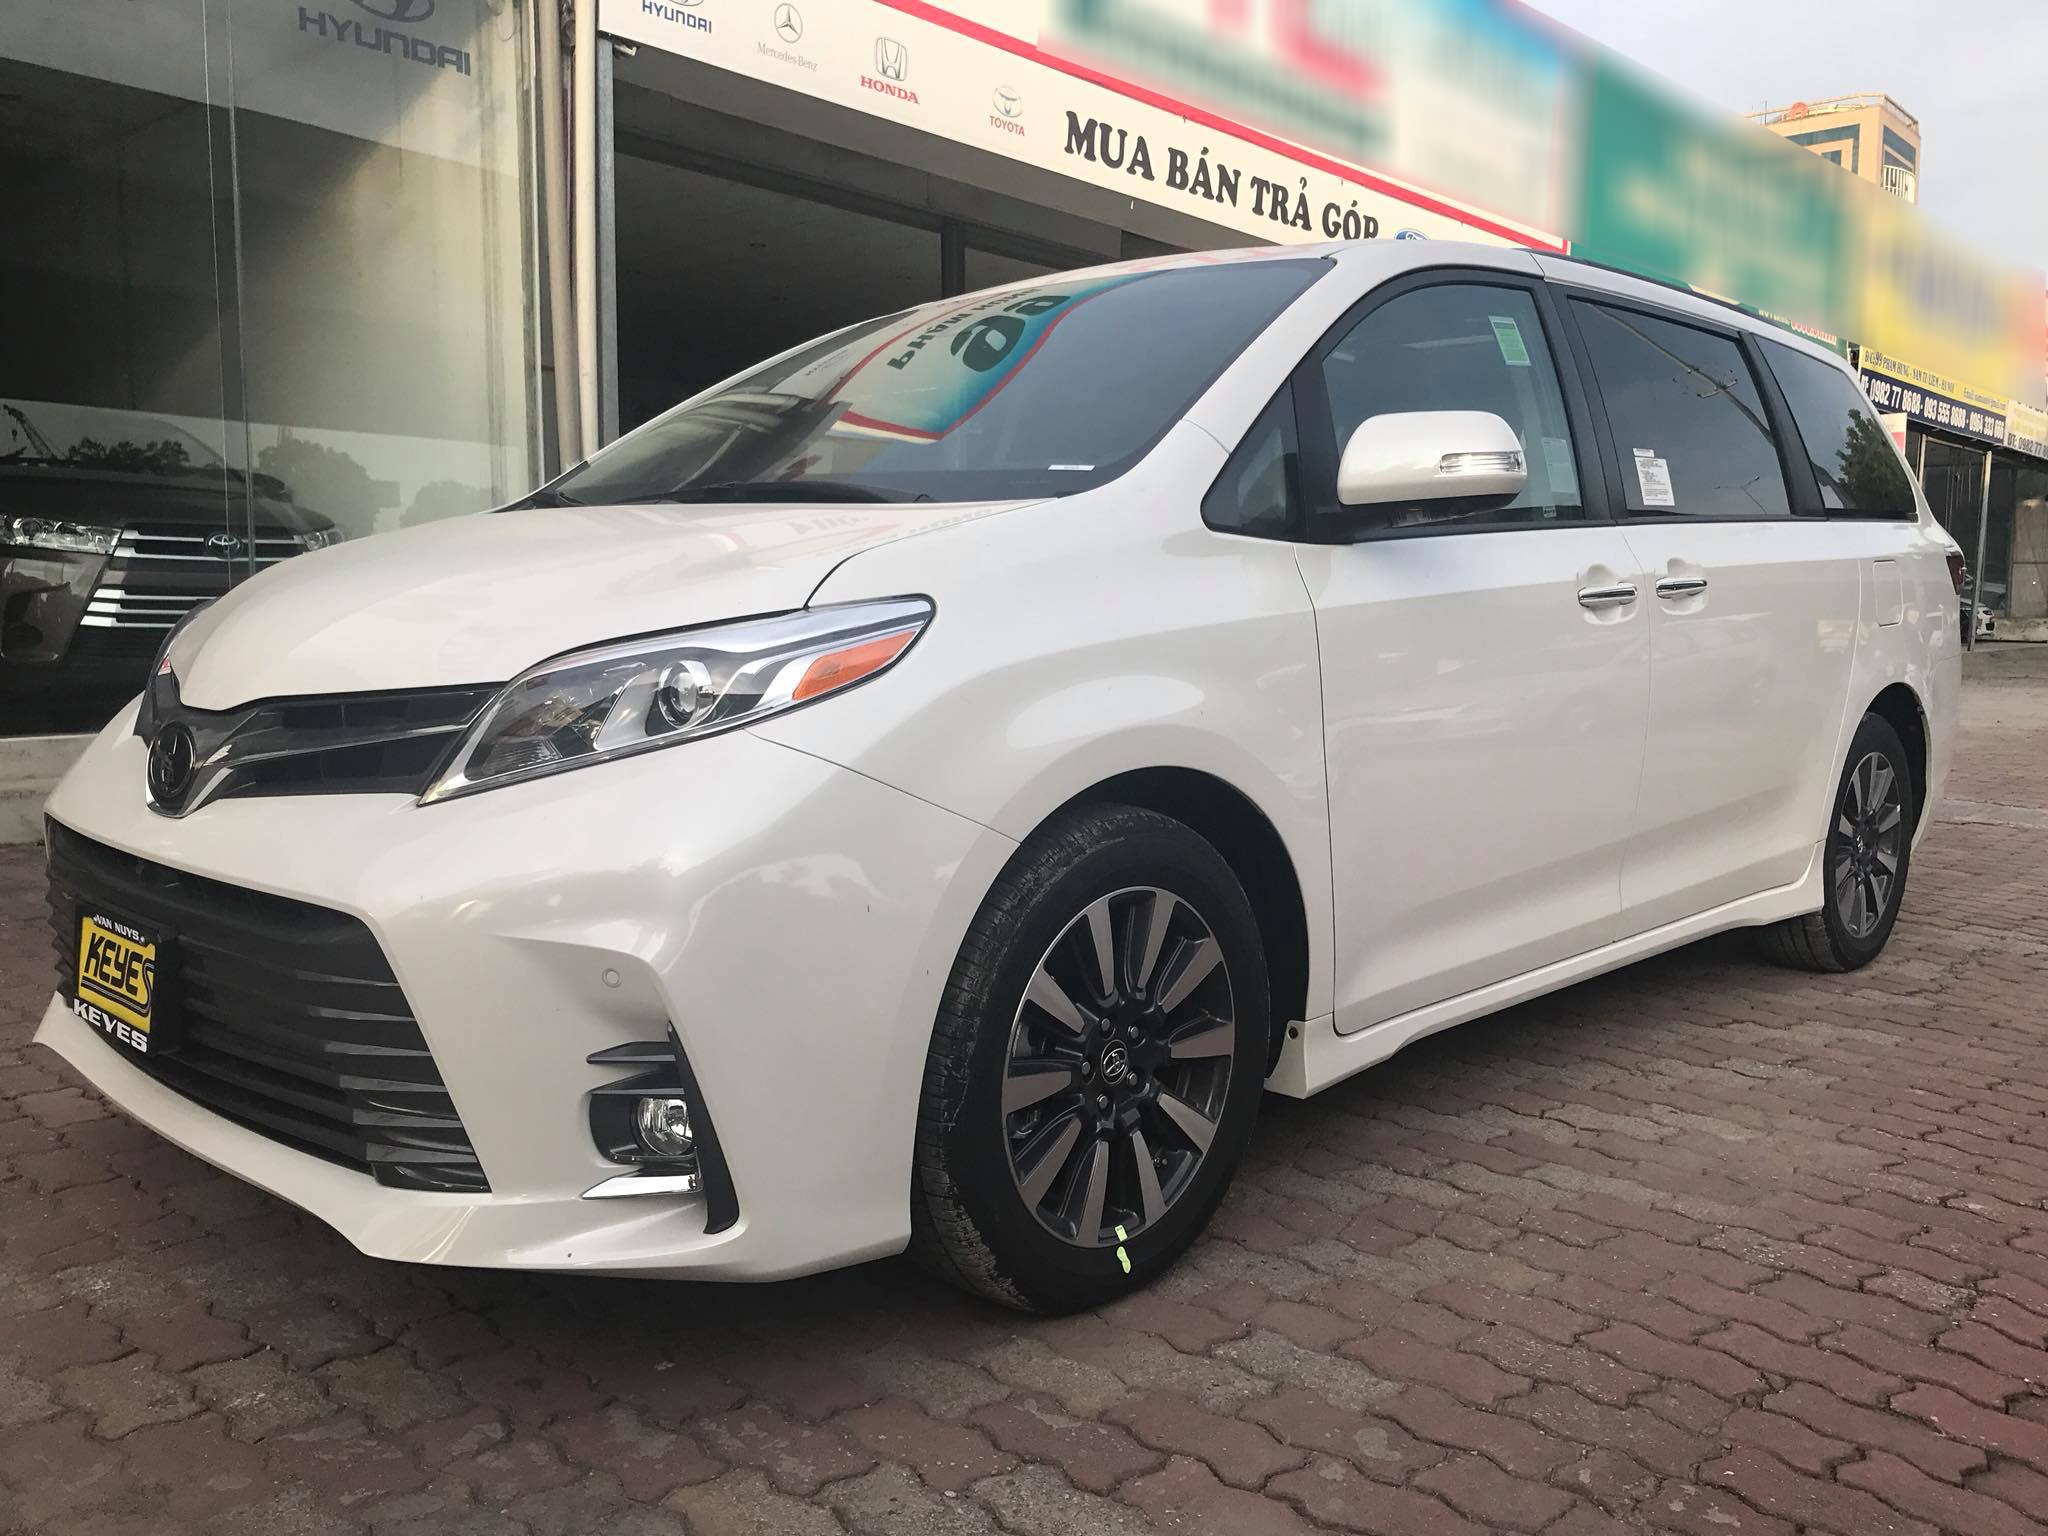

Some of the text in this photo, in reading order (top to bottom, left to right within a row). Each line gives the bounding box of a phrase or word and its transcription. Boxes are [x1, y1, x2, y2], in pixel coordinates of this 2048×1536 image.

[642, 0, 712, 34] HYUNDAI
[298, 6, 471, 76] HYUNDAI
[859, 75, 920, 104] HONDA
[989, 116, 1025, 137] TOYOTA
[1064, 110, 1379, 240] MUA BÁN TRẢ GÓP
[1870, 378, 1890, 406] 0982
[1891, 385, 1902, 409] 77
[1938, 401, 1951, 424] 555
[96, 914, 139, 942] VAN NUYS
[83, 932, 155, 1009] KEYES
[73, 997, 148, 1053] KEYES
